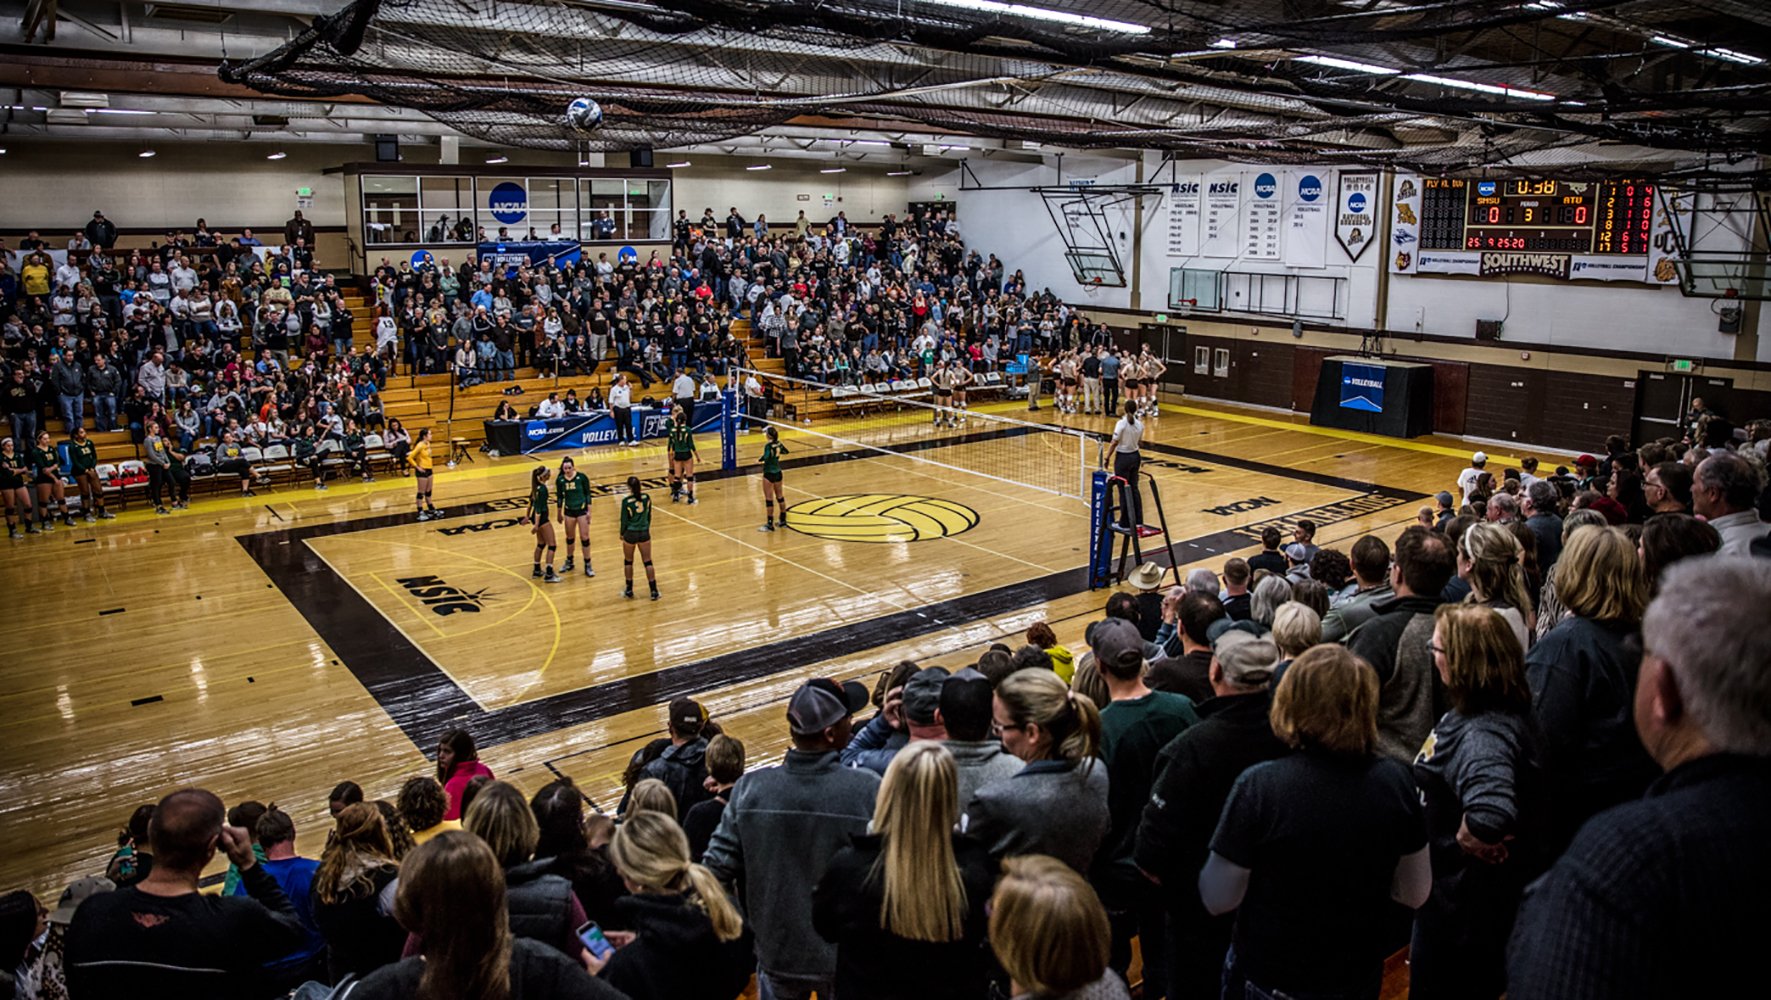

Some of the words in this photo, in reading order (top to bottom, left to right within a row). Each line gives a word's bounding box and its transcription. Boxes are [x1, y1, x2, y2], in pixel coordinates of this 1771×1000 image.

[1209, 182, 1239, 193] NSIC
[1256, 185, 1276, 193] NCAA
[1300, 188, 1322, 196] NCAA
[1476, 197, 1500, 205] SMSU
[1562, 196, 1583, 205] ATU
[1488, 206, 1500, 223] 0
[1524, 208, 1533, 222] 3
[1575, 206, 1587, 223] 0
[1482, 253, 1570, 272] SOUTHWEST
[1484, 267, 1534, 275] MINNESOTA
[383, 320, 394, 328] 13
[1352, 378, 1383, 389] VOLLEYBALL
[635, 500, 644, 513] 3
[1202, 496, 1282, 516] NCAA
[396, 575, 480, 616] NSIC
